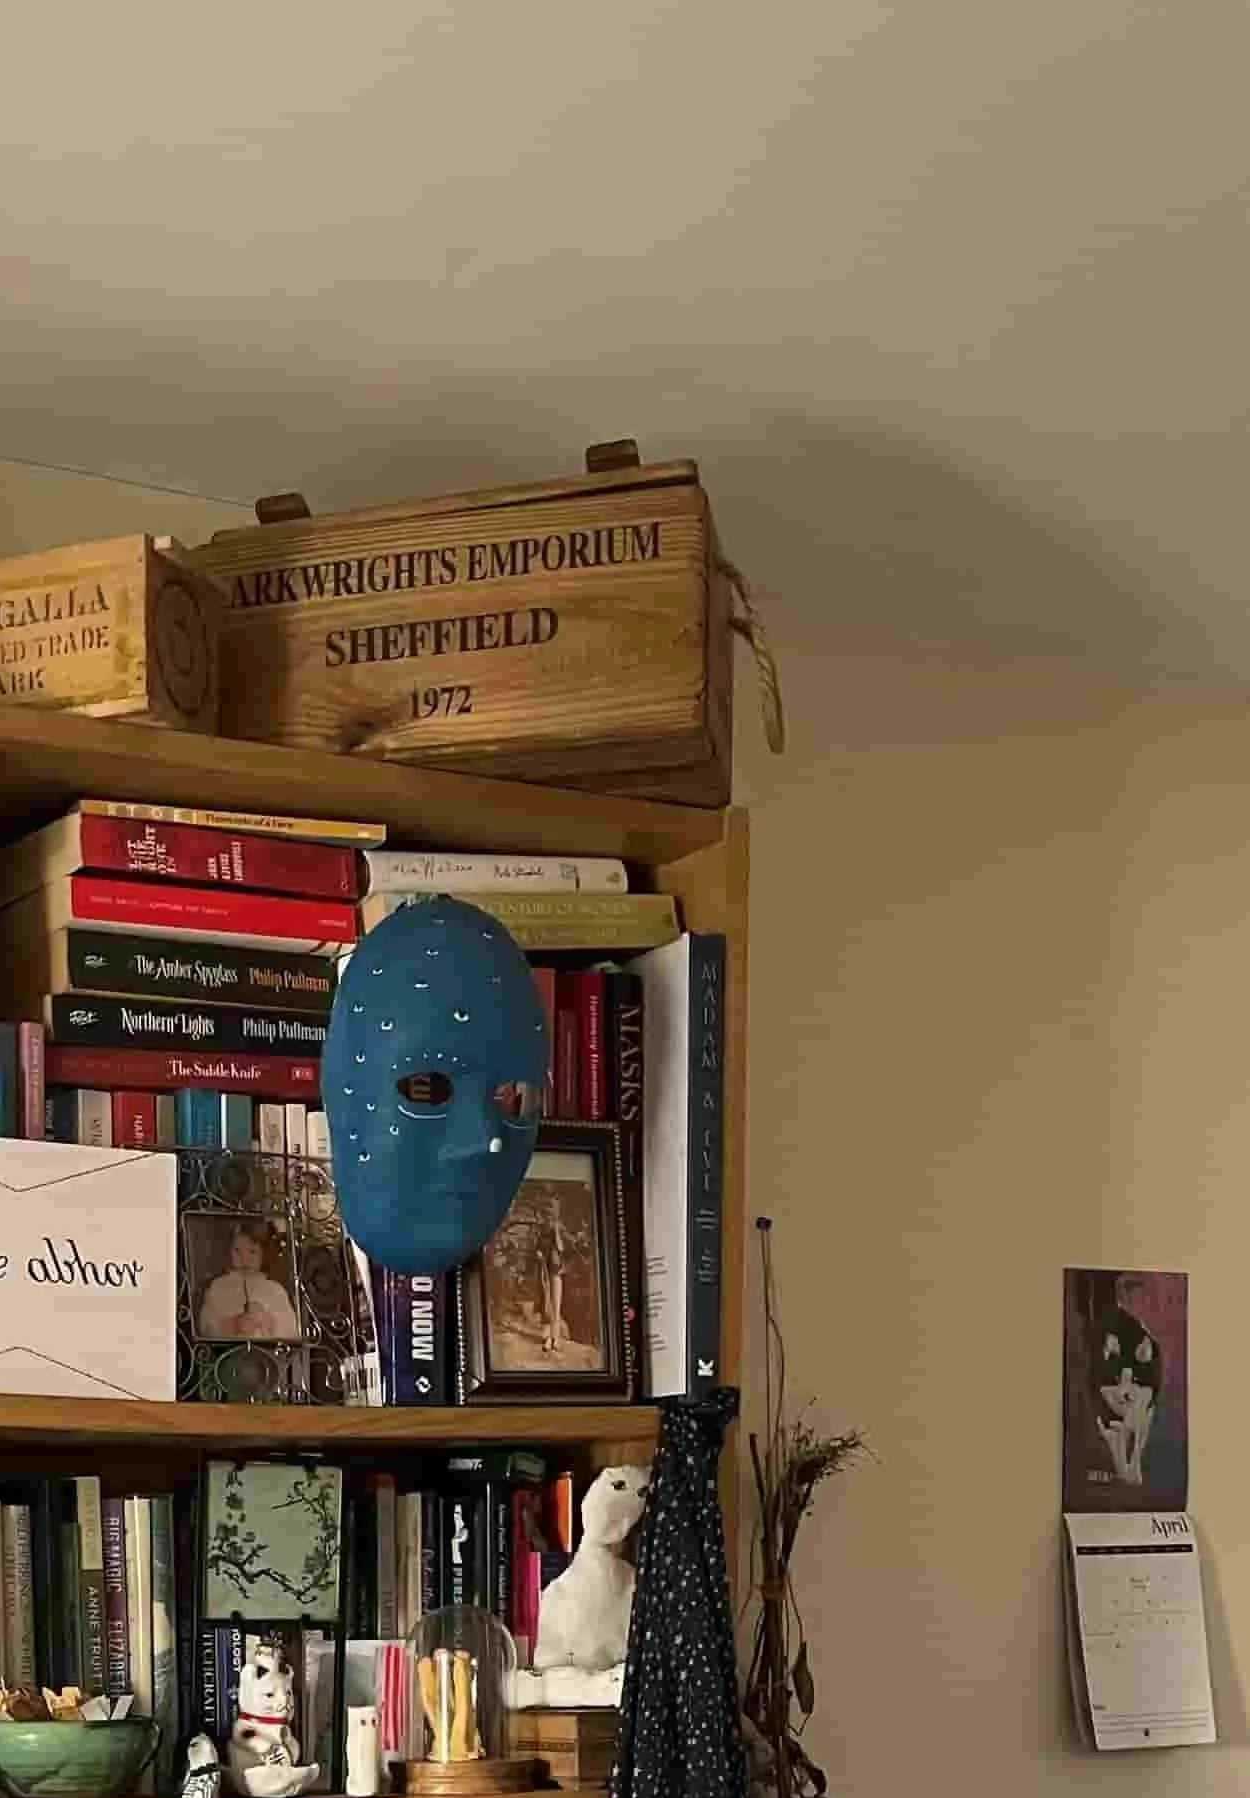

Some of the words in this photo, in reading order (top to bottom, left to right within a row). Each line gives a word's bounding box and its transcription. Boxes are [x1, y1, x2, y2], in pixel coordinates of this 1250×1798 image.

[230, 547, 457, 610] ARKWRIGHTS
[466, 520, 662, 583] EMPORIUM
[33, 625, 110, 661] TRADE
[324, 606, 560, 668] SHEFFIELD
[407, 685, 473, 722] 1972
[134, 954, 155, 972] The
[154, 956, 193, 981] Amber
[193, 960, 239, 989] Spyglass
[249, 966, 283, 992] Philip
[121, 1006, 176, 1035] Northern
[179, 1014, 215, 1040] Lights
[242, 1016, 277, 1043] Philip
[277, 1018, 327, 1042] Pullman
[619, 1004, 644, 1122] MASKS
[26, 1236, 144, 1288] abhor
[411, 1300, 435, 1361] NOW
[1151, 1515, 1190, 1539] April
[107, 1545, 124, 1593] MAGIC
[85, 1585, 103, 1632] ANNE
